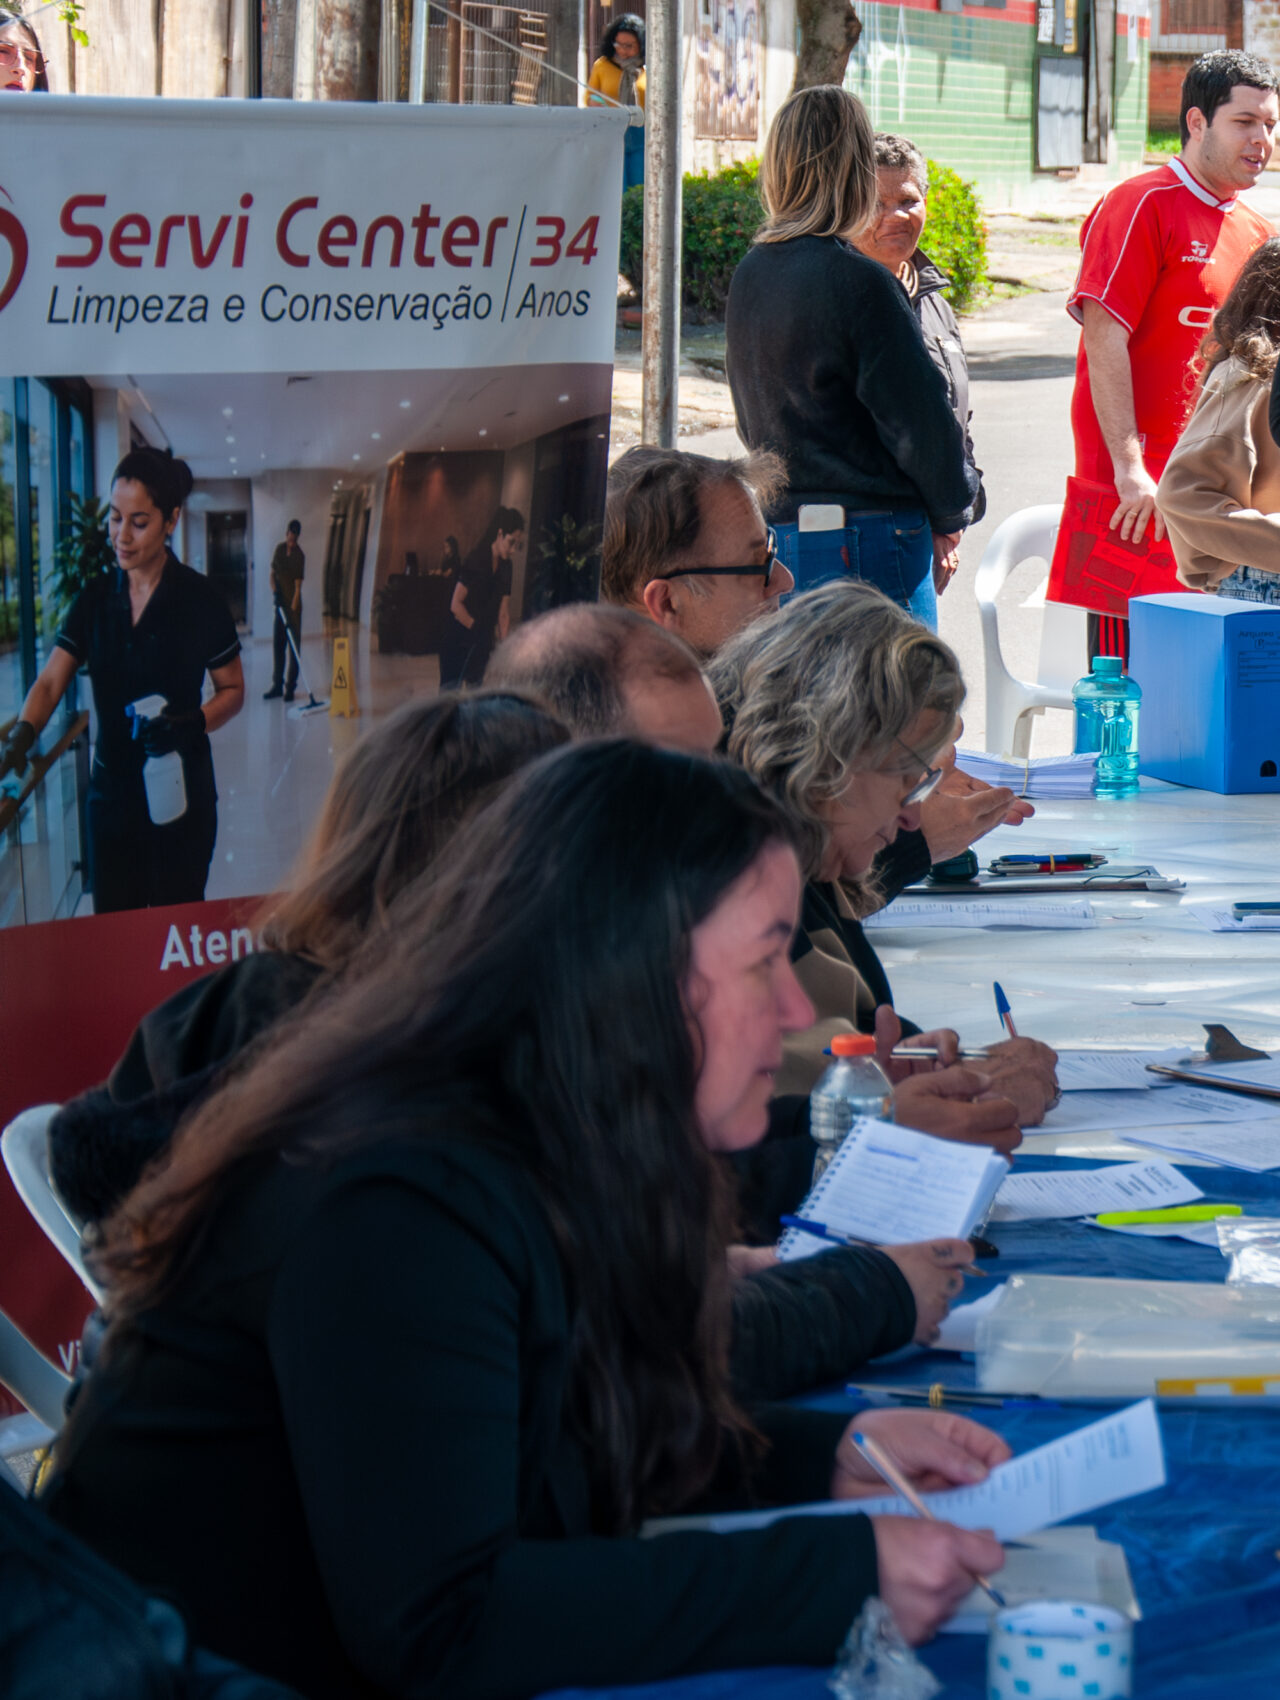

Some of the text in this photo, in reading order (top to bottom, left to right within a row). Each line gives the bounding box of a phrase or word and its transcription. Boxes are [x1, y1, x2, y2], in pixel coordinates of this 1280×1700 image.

[55, 192, 509, 269] Servi Center
[529, 215, 600, 267] 34
[47, 284, 492, 333] Limpeza e Conservação
[515, 282, 591, 318] Anos
[159, 923, 265, 971] Aten
